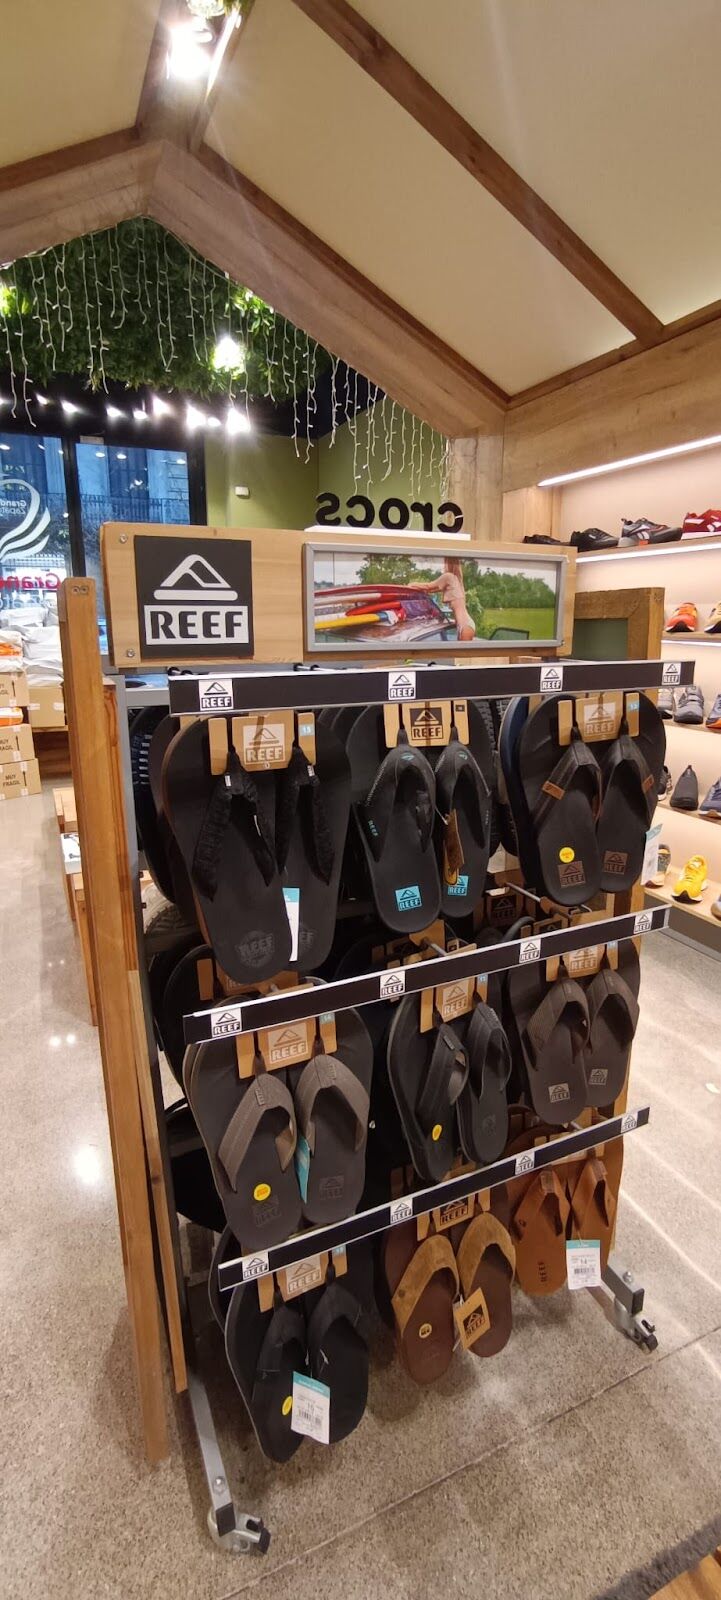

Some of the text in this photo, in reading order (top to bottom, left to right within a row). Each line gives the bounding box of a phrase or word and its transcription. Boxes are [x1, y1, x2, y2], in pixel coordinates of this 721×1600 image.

[150, 610, 243, 639] REEF
[663, 675, 680, 683] REEF
[542, 681, 561, 690] REEF
[390, 688, 414, 698] REEF
[201, 696, 232, 708] REEF
[413, 728, 441, 738] REEF
[586, 723, 614, 734] REEF
[246, 747, 284, 761] REEF
[399, 899, 420, 910] REEF
[521, 951, 539, 961] REEF
[571, 958, 597, 971] REEF
[381, 984, 404, 996] REEF
[444, 997, 469, 1015] REEF
[213, 1024, 241, 1034] REEF
[271, 1042, 308, 1062] REEF
[392, 1209, 412, 1223] REEF
[442, 1209, 467, 1225] REEF
[244, 1265, 268, 1279] REEF
[288, 1271, 320, 1290] REEF
